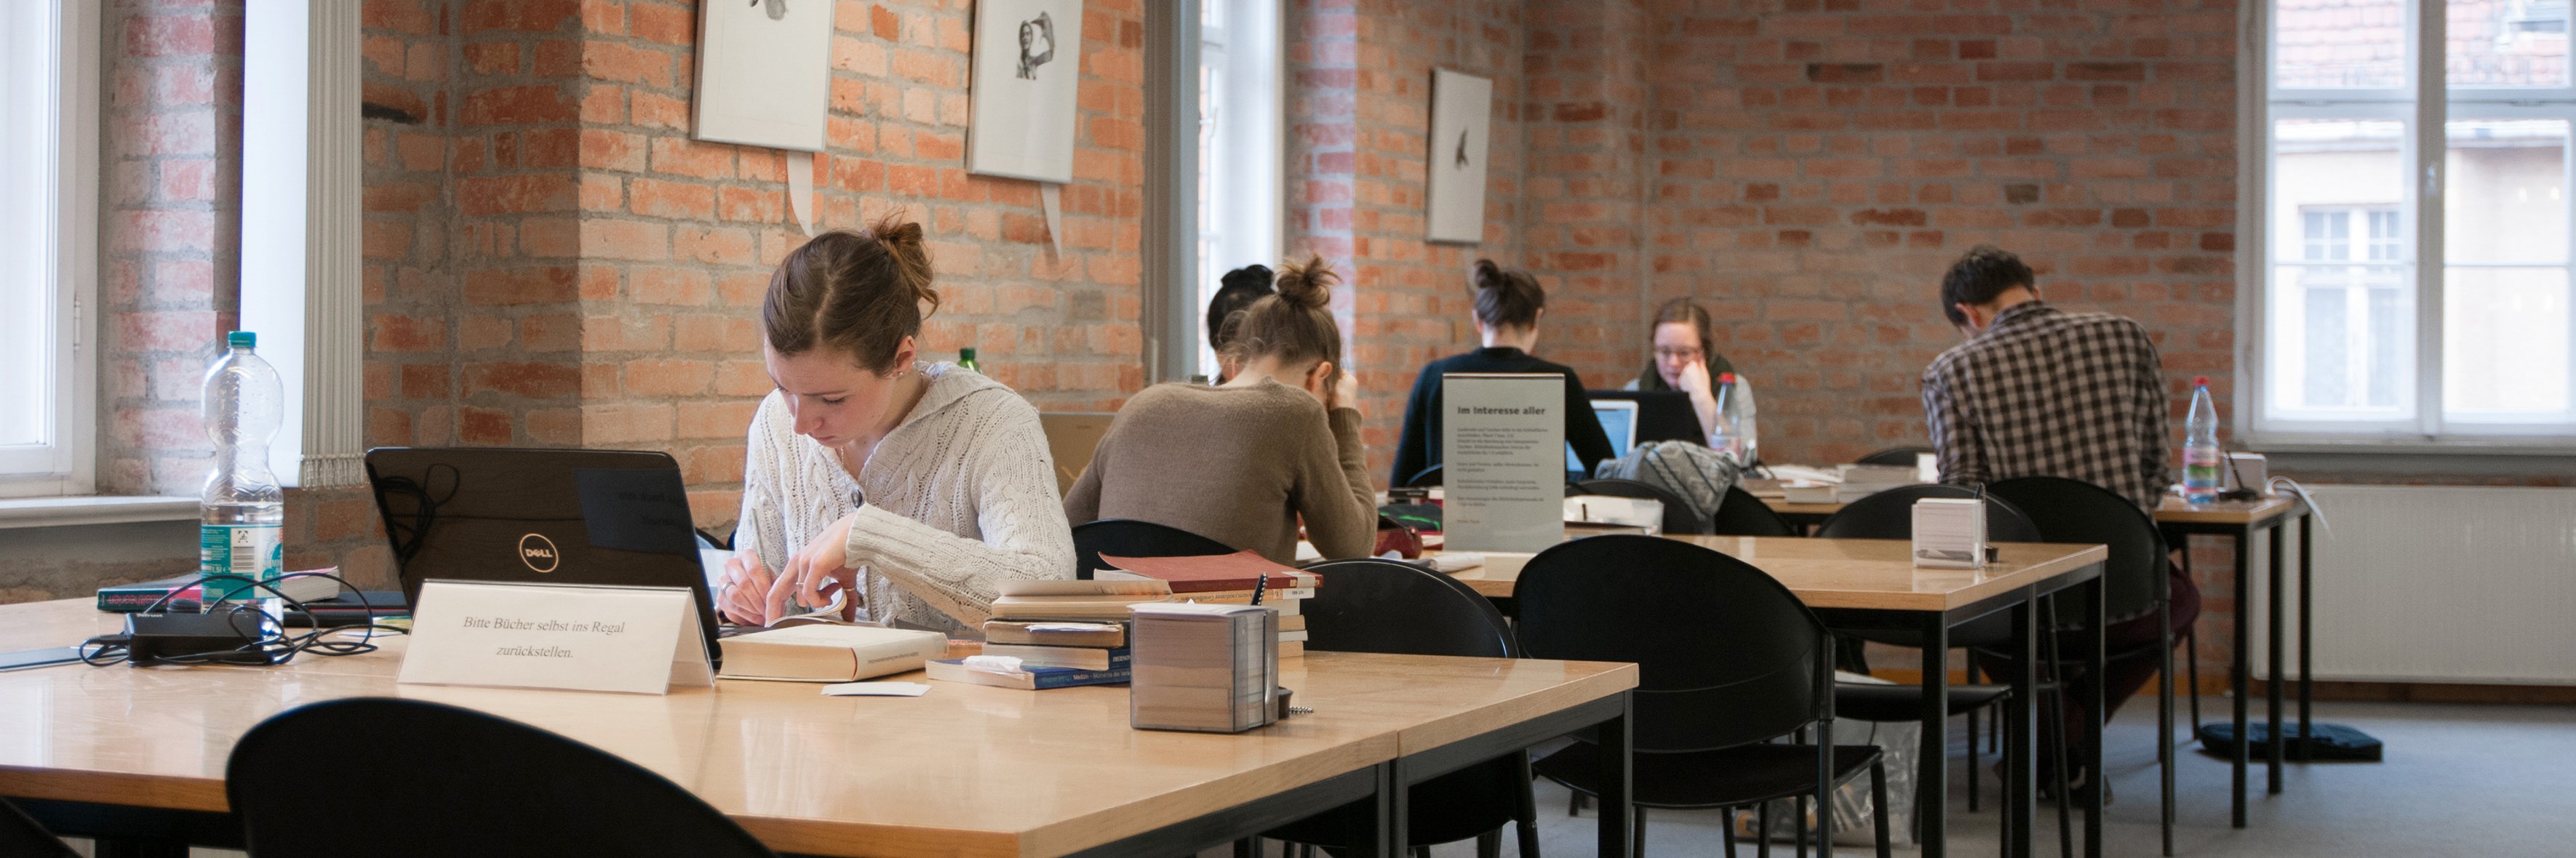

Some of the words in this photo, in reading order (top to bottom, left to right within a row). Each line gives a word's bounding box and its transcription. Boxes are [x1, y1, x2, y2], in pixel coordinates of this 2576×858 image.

[525, 549, 553, 558] DELL
[463, 617, 490, 628] Bitte
[493, 617, 535, 630] Bücher
[537, 620, 569, 631] selbst
[572, 621, 589, 632] ins
[591, 621, 626, 636] Regal
[496, 646, 573, 658] zurückstellen.
